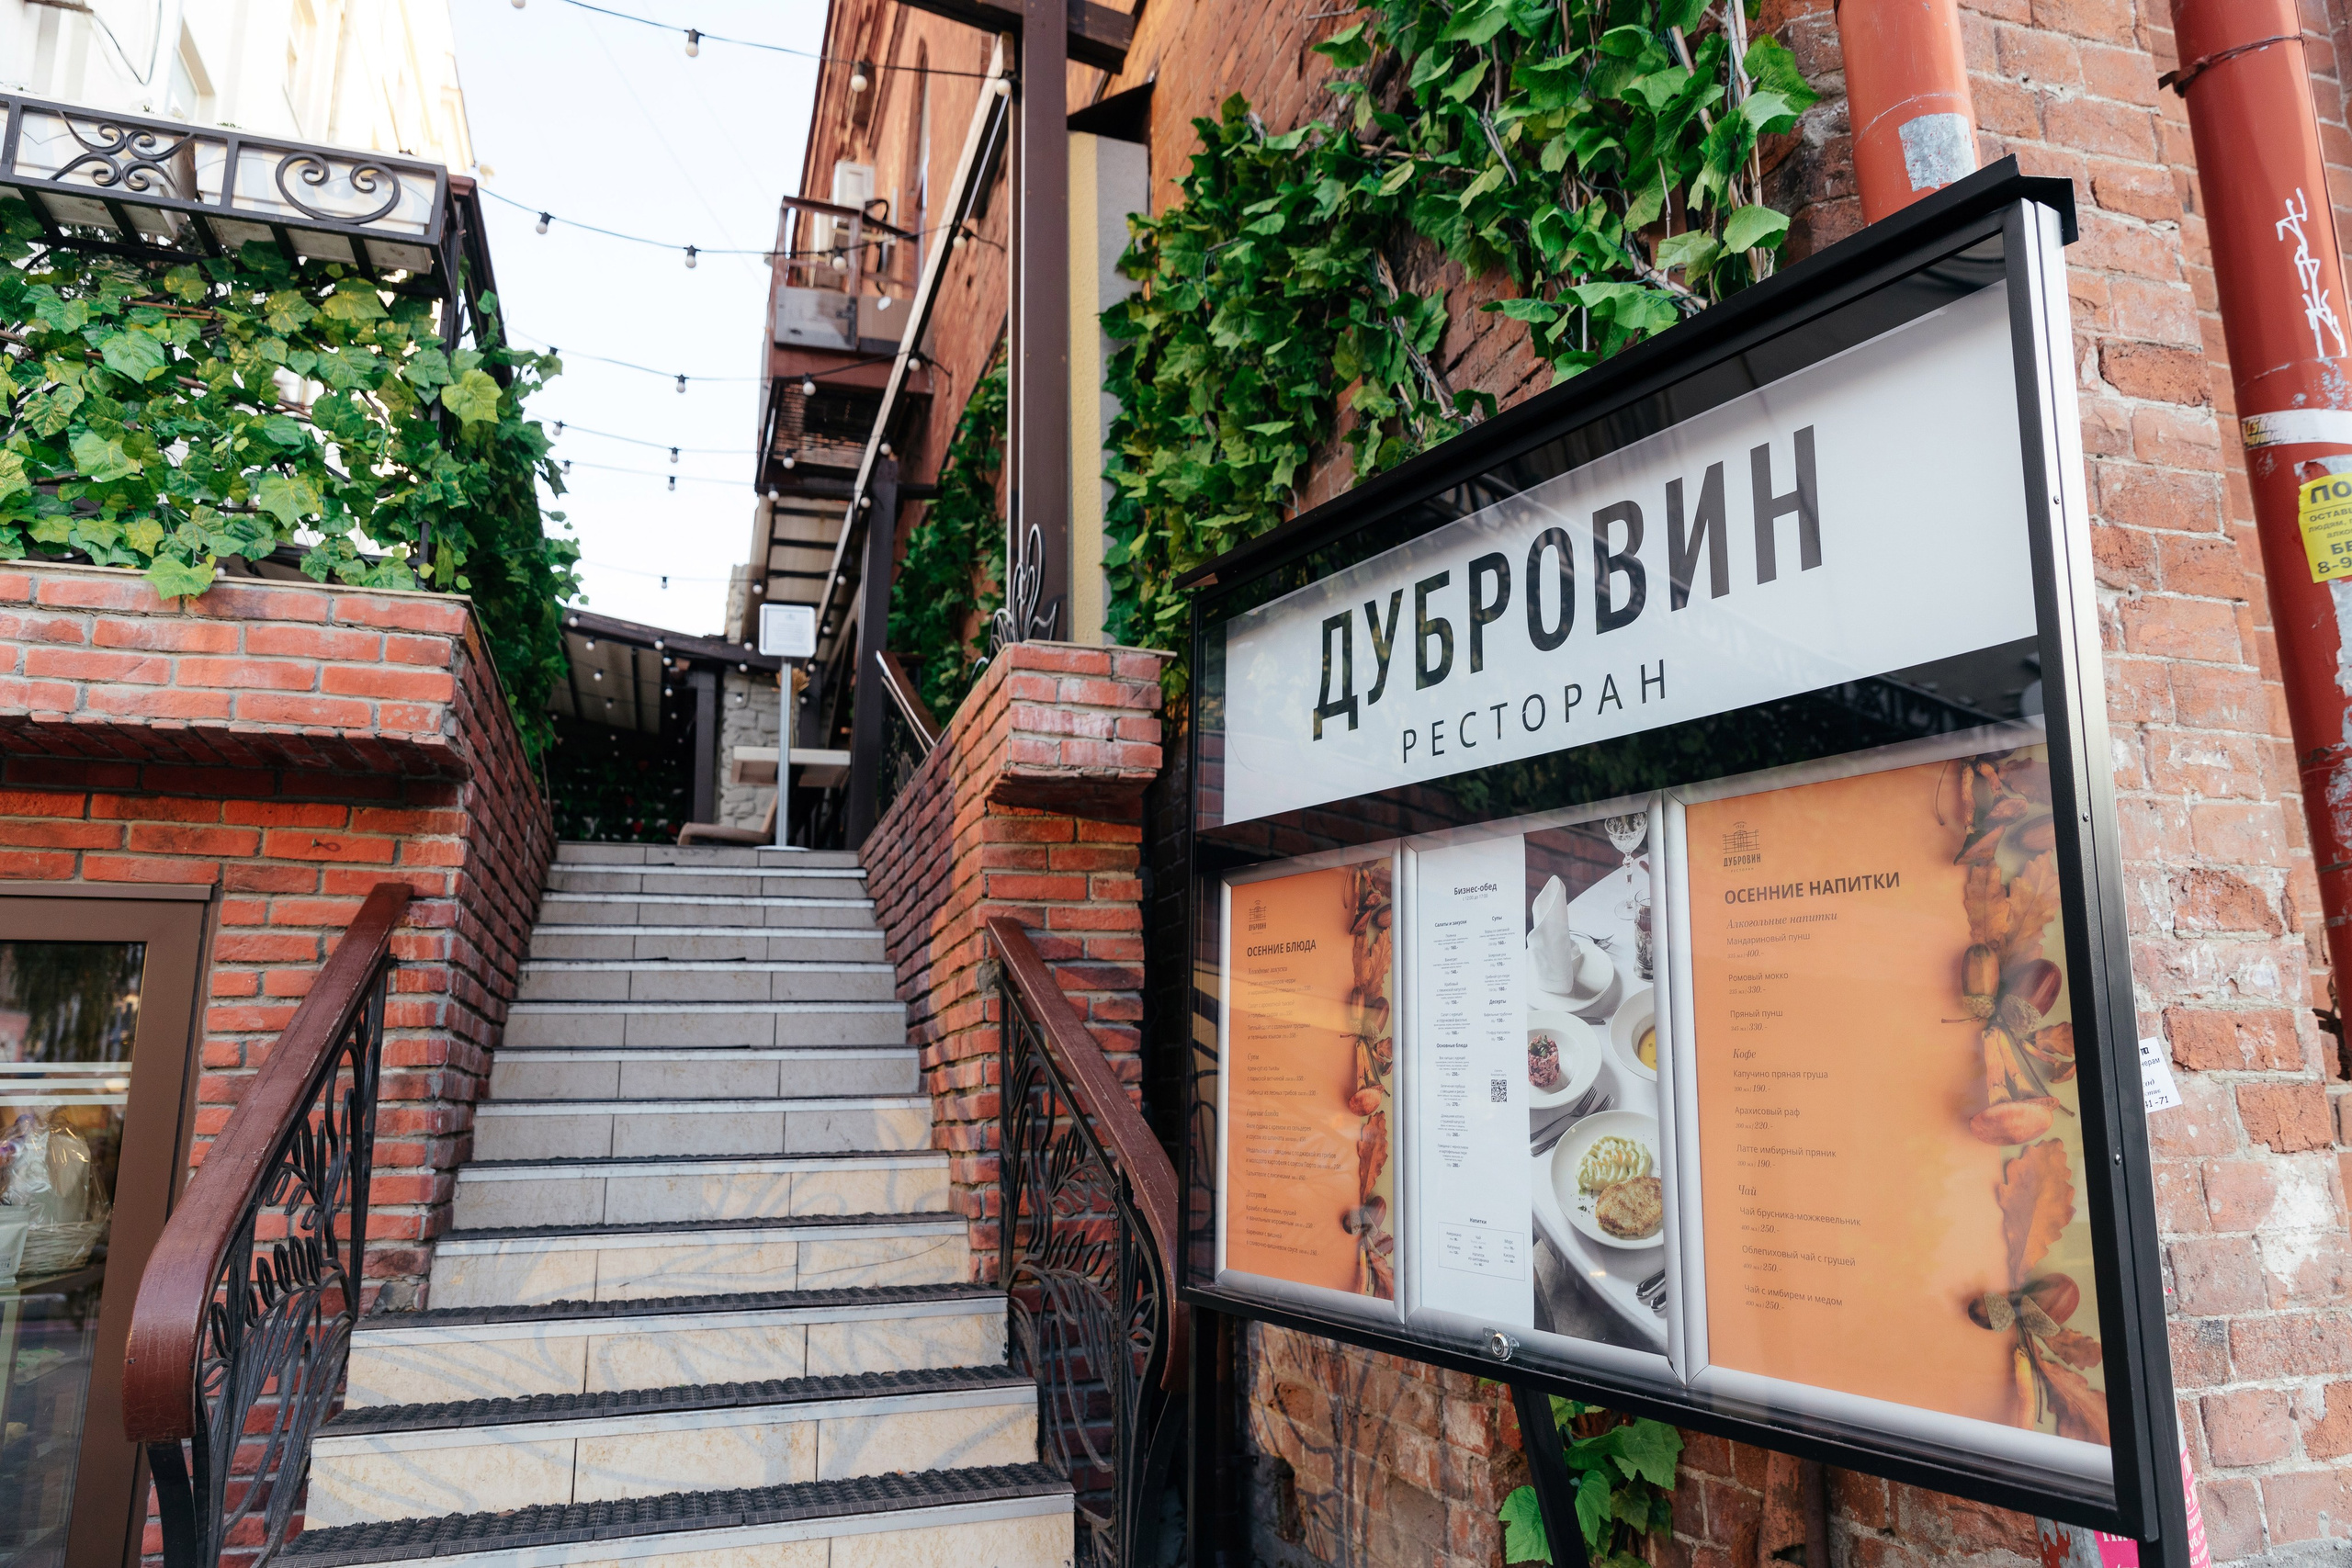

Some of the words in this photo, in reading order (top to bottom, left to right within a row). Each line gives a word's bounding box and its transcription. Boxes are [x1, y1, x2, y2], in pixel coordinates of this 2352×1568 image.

[1313, 424, 1822, 742] ДУБРОВИН
[1402, 660, 1666, 763] РЕСТОРАН
[1724, 853, 1761, 867] ДУБРОВИН
[1453, 883, 1498, 896] Бизнес-обед
[1724, 883, 1804, 905] ОСЕННИЕ
[1809, 872, 1900, 896] НАПИТКИ
[1726, 916, 1787, 930] Алкогольные
[1790, 911, 1838, 925] напитки
[1726, 933, 1786, 946] Мандариновый
[1789, 932, 1811, 942] пунш
[1247, 943, 1284, 957] ОСЕННИЕ
[1286, 939, 1317, 953] БЛЮДА
[1728, 972, 1763, 982] Ромовый
[1765, 972, 1789, 980] мокко
[1730, 1010, 1760, 1020] Пряный
[1761, 1010, 1783, 1020] пунш
[1733, 1048, 1756, 1061] Кофе
[1733, 1069, 1770, 1079] Капучино
[1771, 1070, 1801, 1079] пряная
[1803, 1070, 1828, 1080] груша
[1735, 1106, 1782, 1117] Арахисовый
[1784, 1108, 1801, 1118] раф
[1736, 1144, 1758, 1154] Латте
[1759, 1145, 1804, 1156] имбирный
[1805, 1148, 1837, 1158] пряник
[1738, 1184, 1757, 1196] Чай
[1739, 1206, 1755, 1216] Чай
[1757, 1208, 1861, 1226] брусника-можжевельник
[1742, 1245, 1799, 1259] Облепиховый
[1800, 1252, 1815, 1261] чай
[1824, 1255, 1856, 1267] грушей
[1744, 1284, 1760, 1294] Чай
[1767, 1288, 1805, 1301] имбирем
[1815, 1295, 1843, 1306] медом
